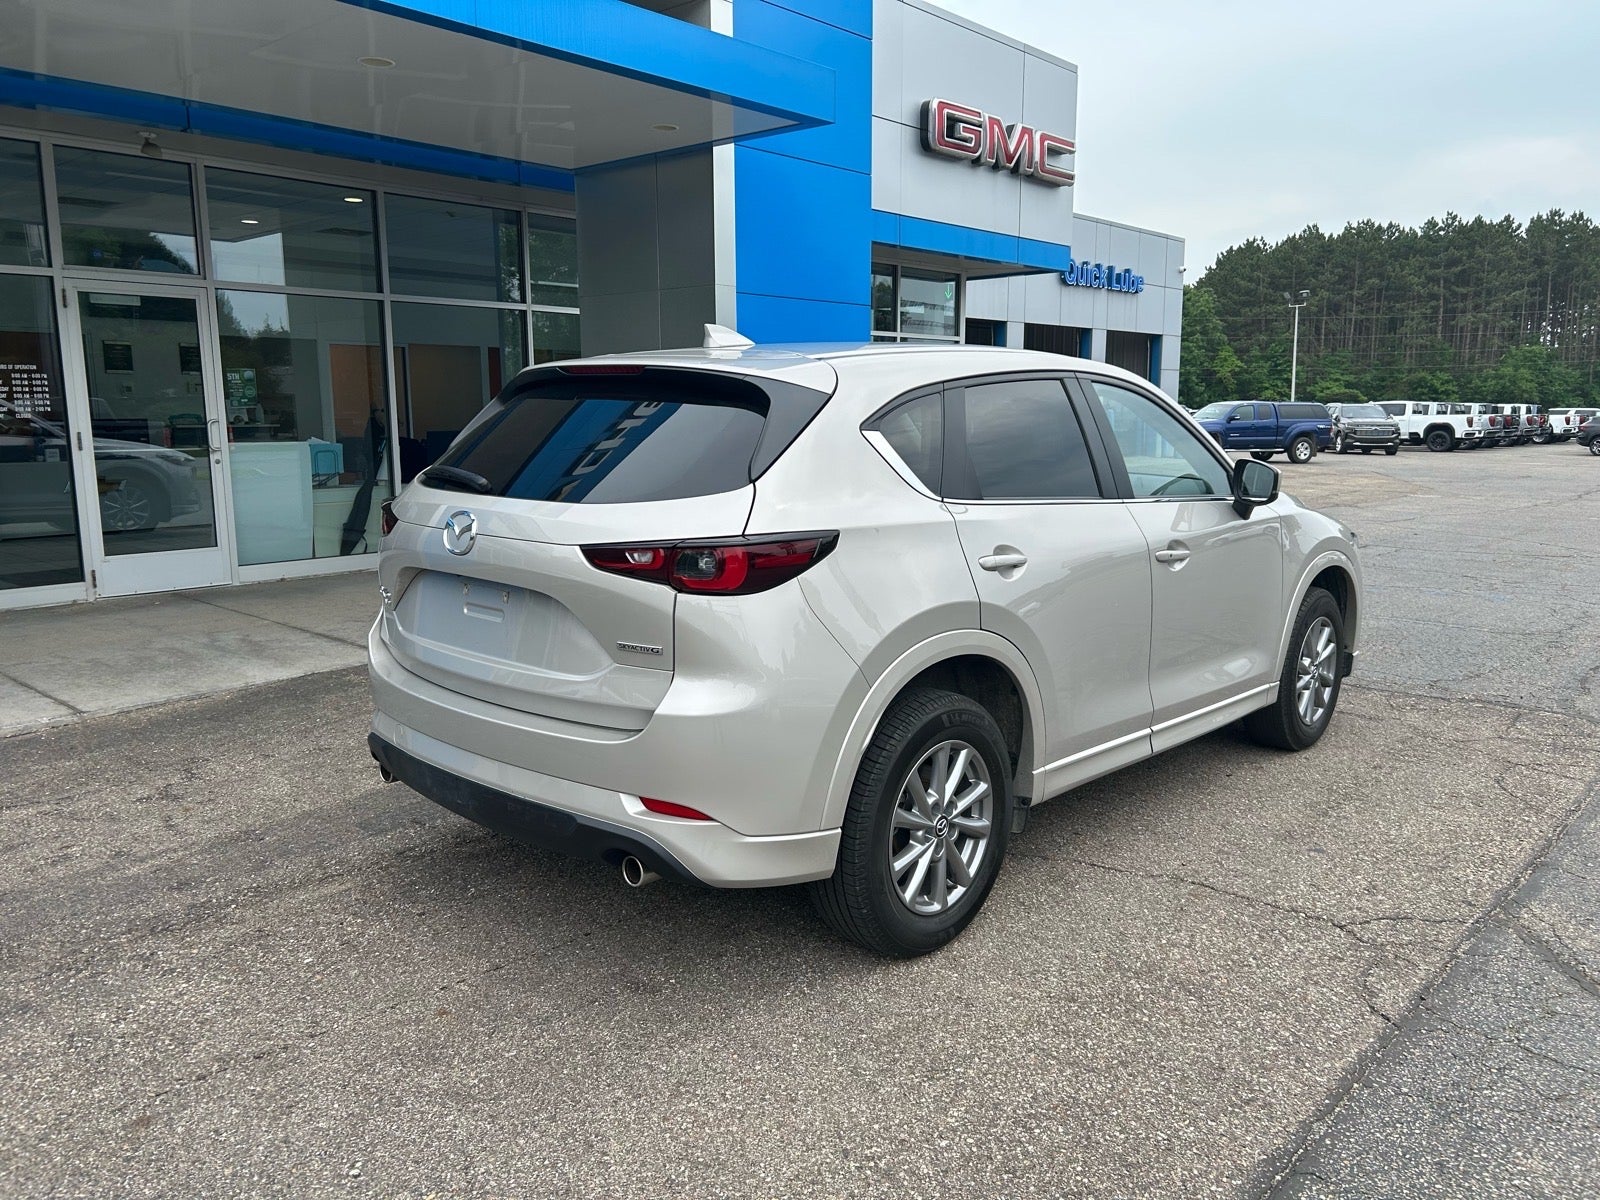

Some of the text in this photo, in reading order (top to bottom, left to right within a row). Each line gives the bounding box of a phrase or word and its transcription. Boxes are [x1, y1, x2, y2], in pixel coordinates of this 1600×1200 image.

[921, 98, 1076, 187] GMC
[1065, 260, 1144, 293] Quick Lube
